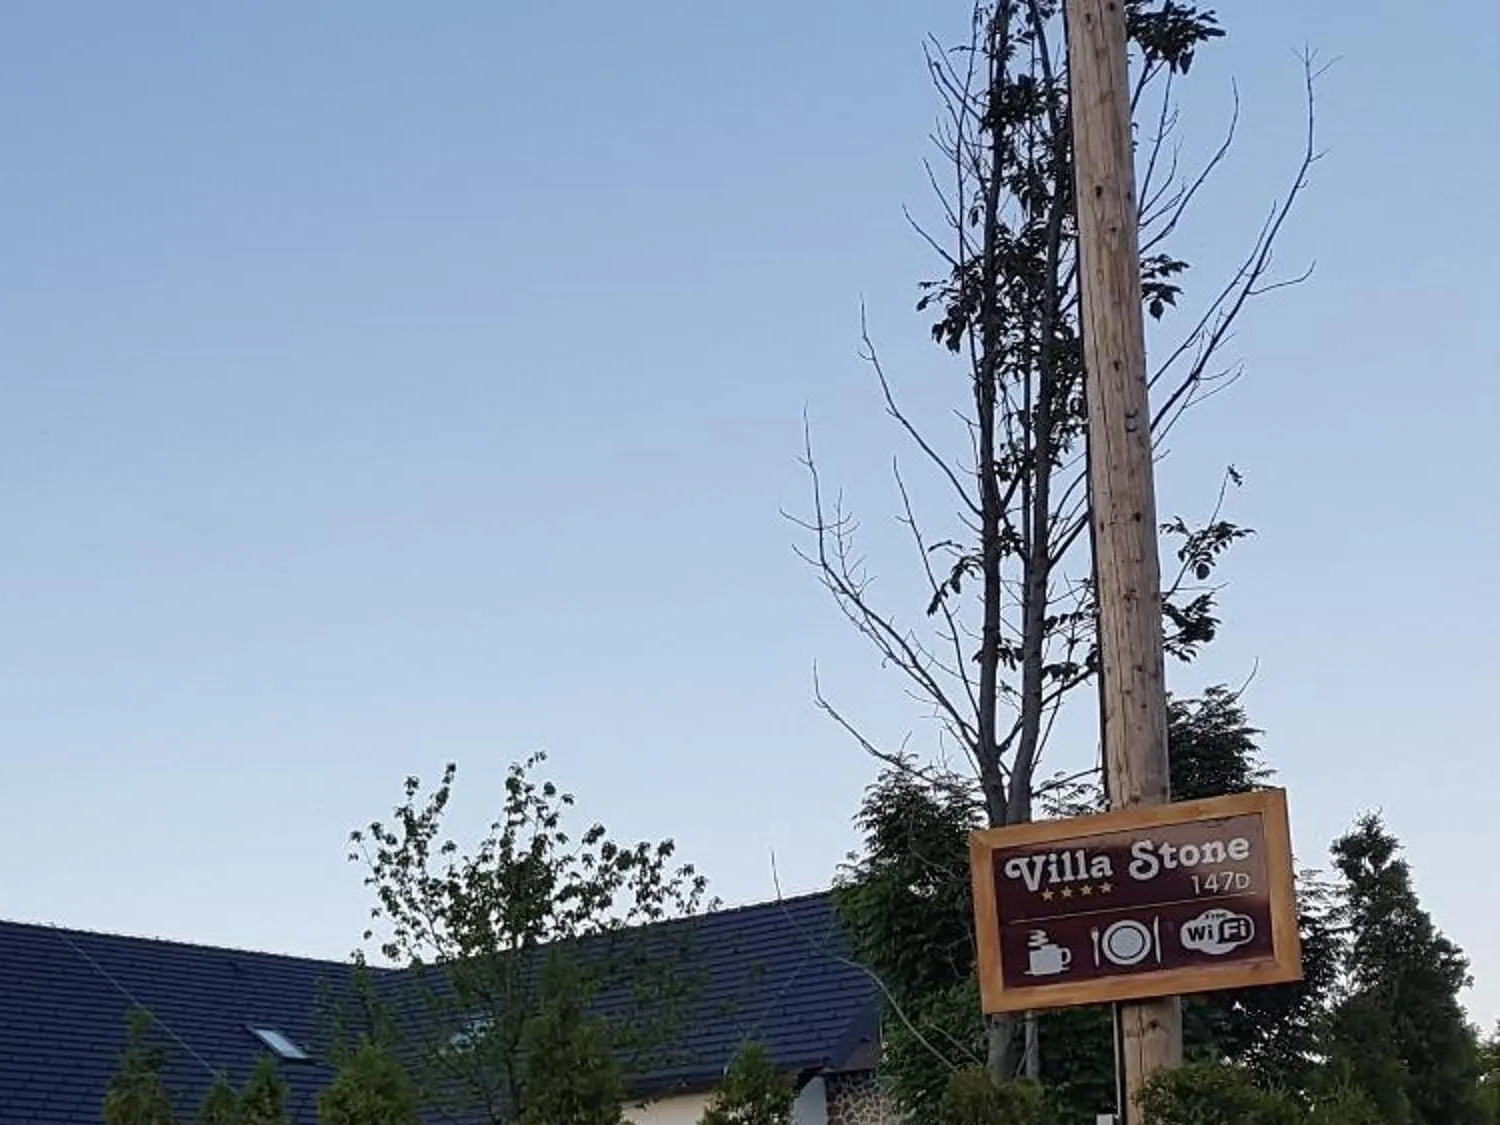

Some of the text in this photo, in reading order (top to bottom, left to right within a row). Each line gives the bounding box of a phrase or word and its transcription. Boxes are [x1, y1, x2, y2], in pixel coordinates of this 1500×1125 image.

[1005, 838, 1249, 892] Villa Stone
[1191, 871, 1250, 895] 147D
